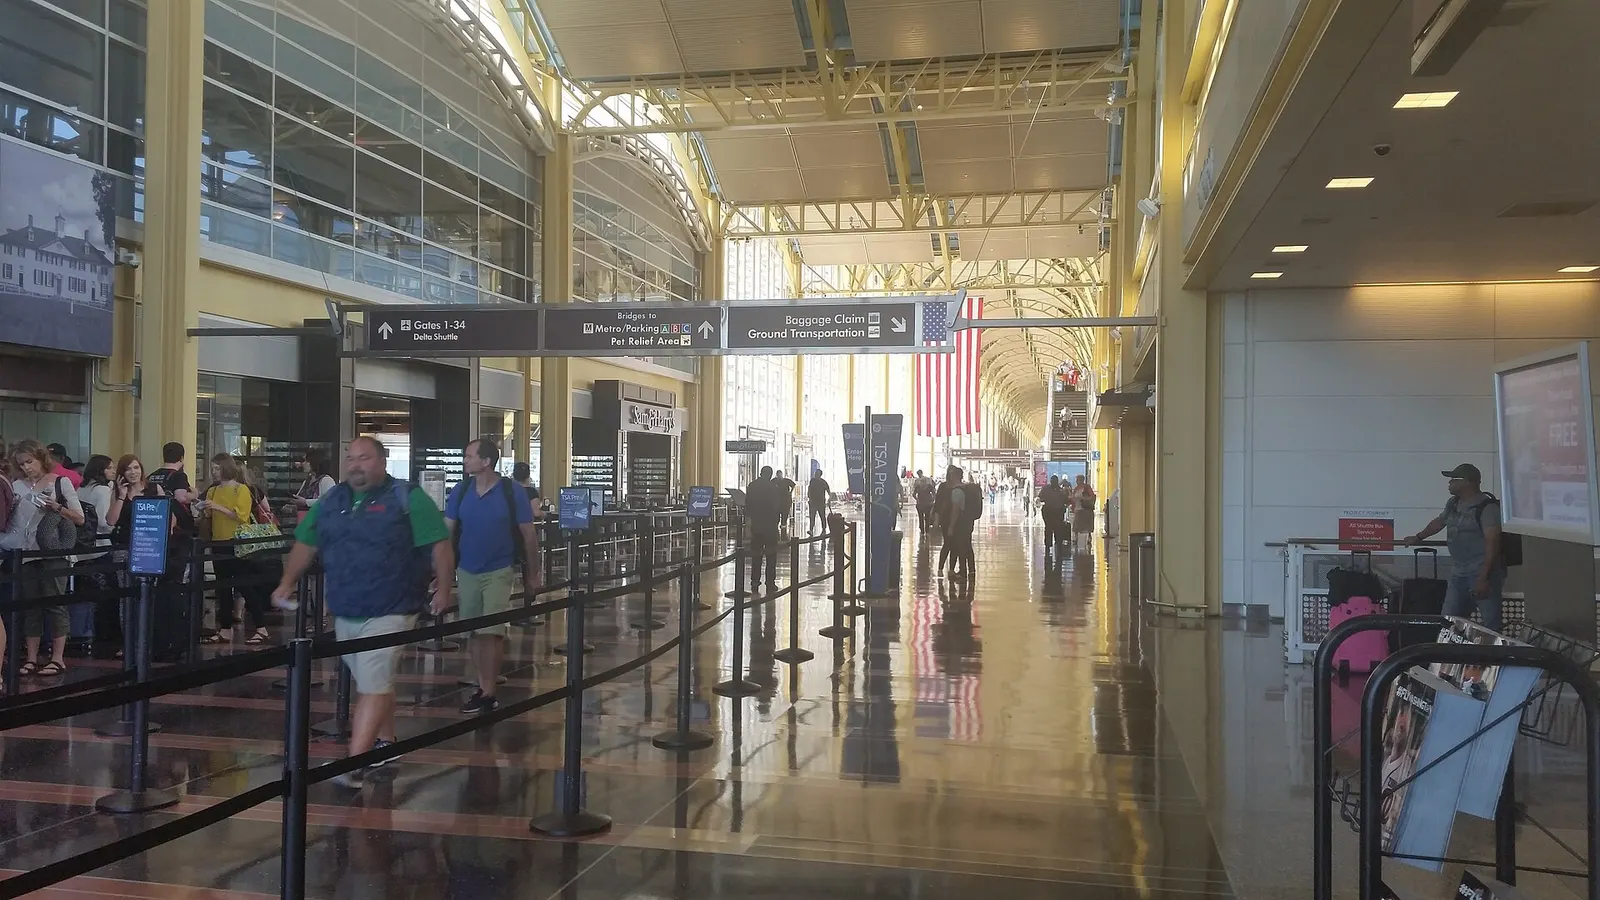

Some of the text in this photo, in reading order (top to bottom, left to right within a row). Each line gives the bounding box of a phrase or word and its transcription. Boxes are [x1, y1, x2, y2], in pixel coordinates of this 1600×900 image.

[617, 312, 646, 321] Bridges
[785, 314, 865, 327] Baggage Claim
[413, 320, 466, 330] Gates 1-34
[594, 324, 660, 334] Metro/Parking
[661, 324, 668, 333] A
[672, 324, 679, 333] B
[682, 324, 690, 333] C
[748, 328, 865, 340] Ground Transportation
[611, 336, 680, 346] Pet Relief Area
[1549, 421, 1578, 448] FREE
[874, 442, 888, 496] TSA Pre
[136, 503, 146, 511] TSA
